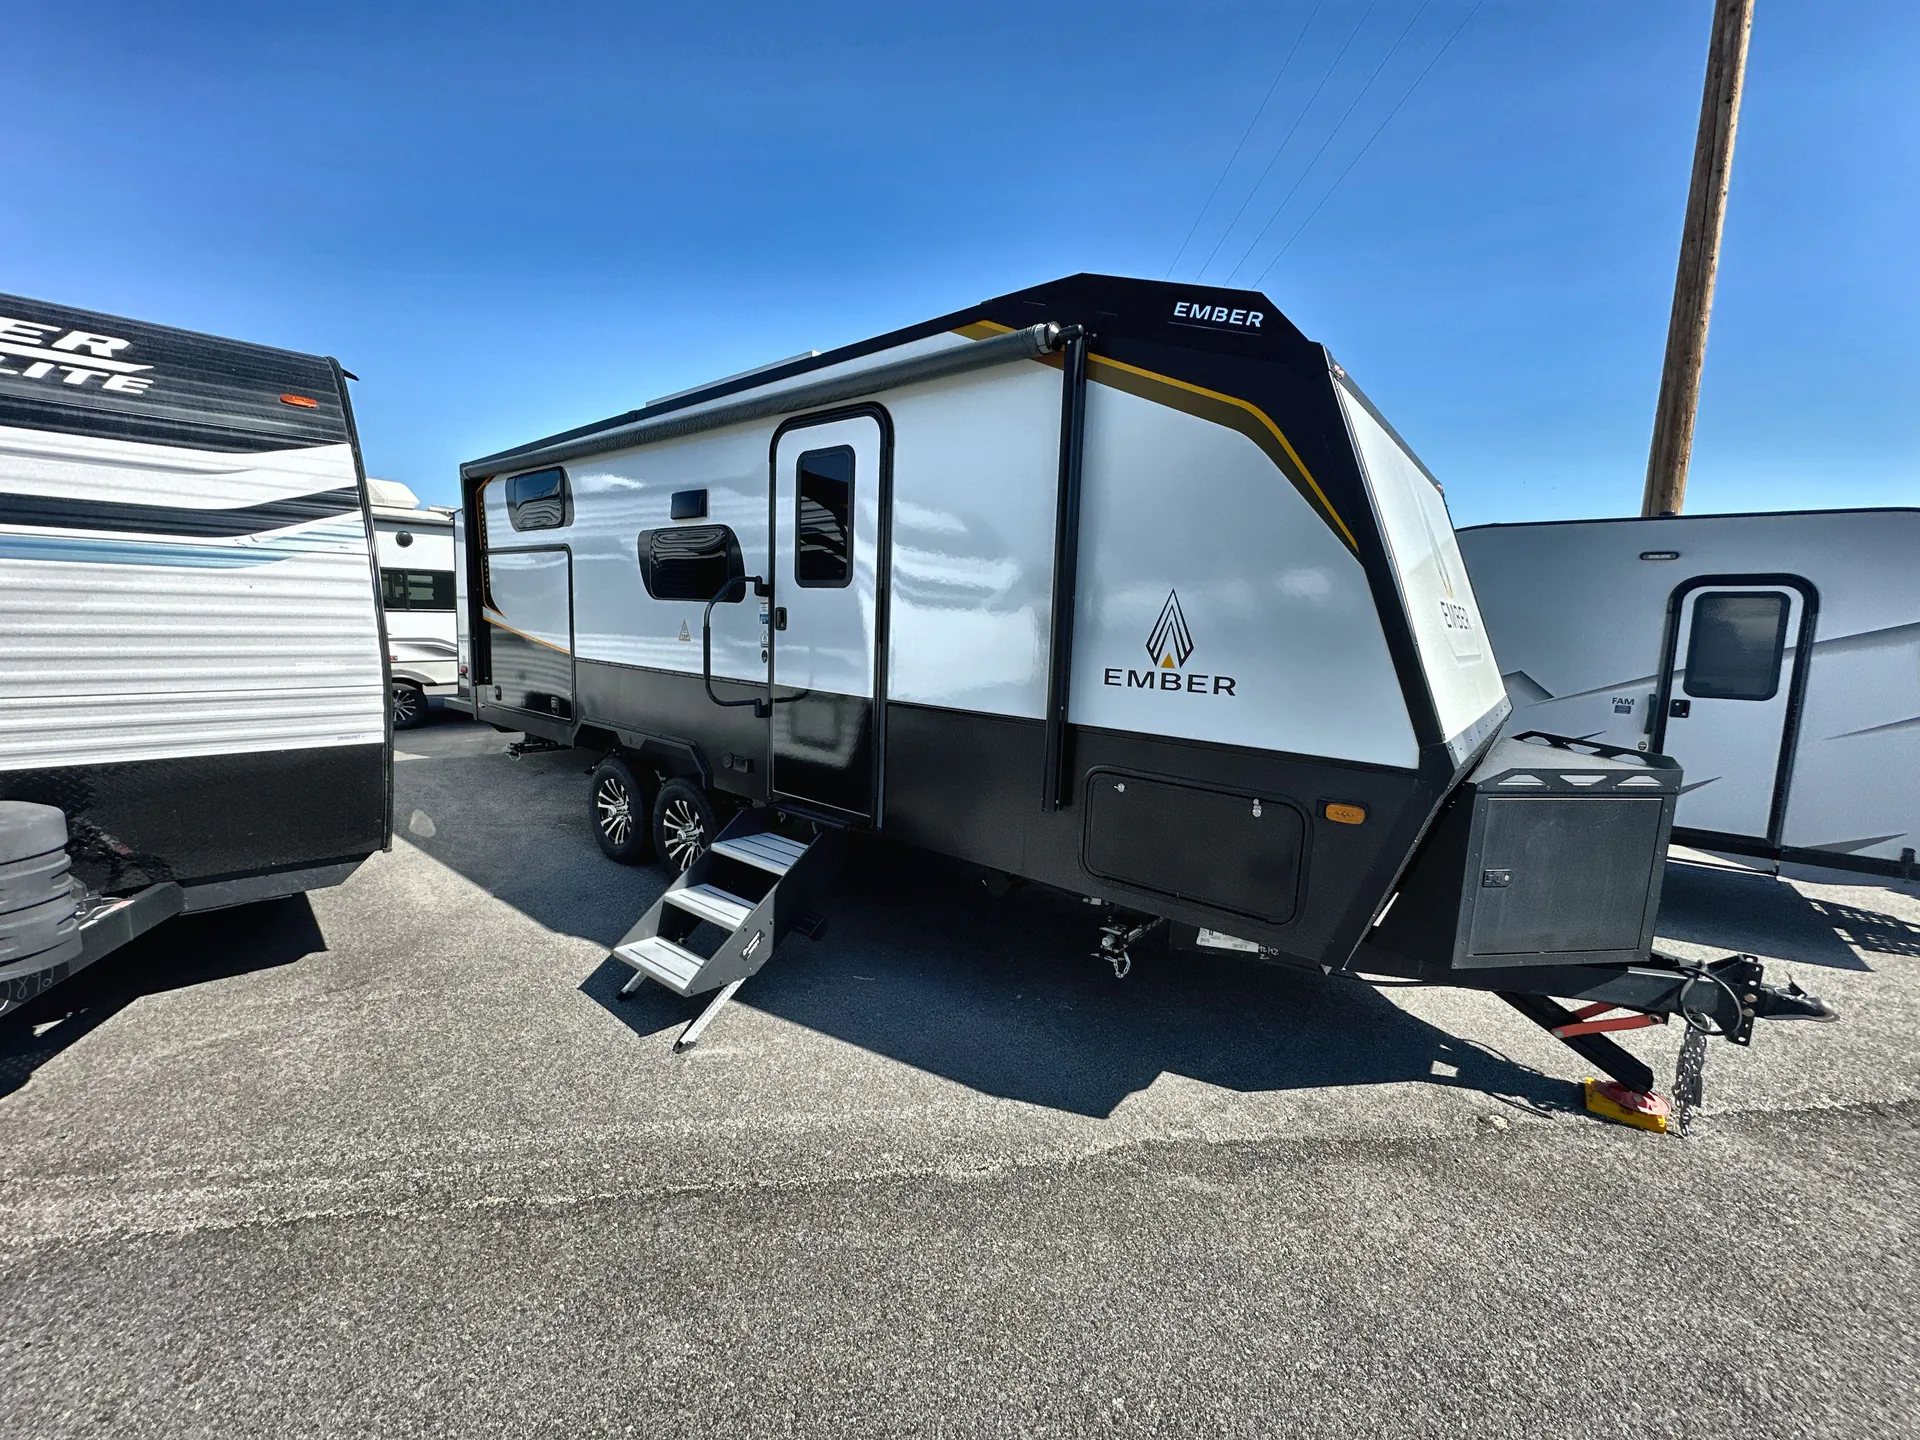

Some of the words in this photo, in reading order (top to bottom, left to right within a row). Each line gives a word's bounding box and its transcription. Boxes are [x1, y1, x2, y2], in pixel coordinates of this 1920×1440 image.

[1173, 301, 1264, 328] EMBER
[1440, 600, 1472, 630] EMBER
[1103, 667, 1237, 697] EMBER
[1612, 697, 1635, 706] FAM
